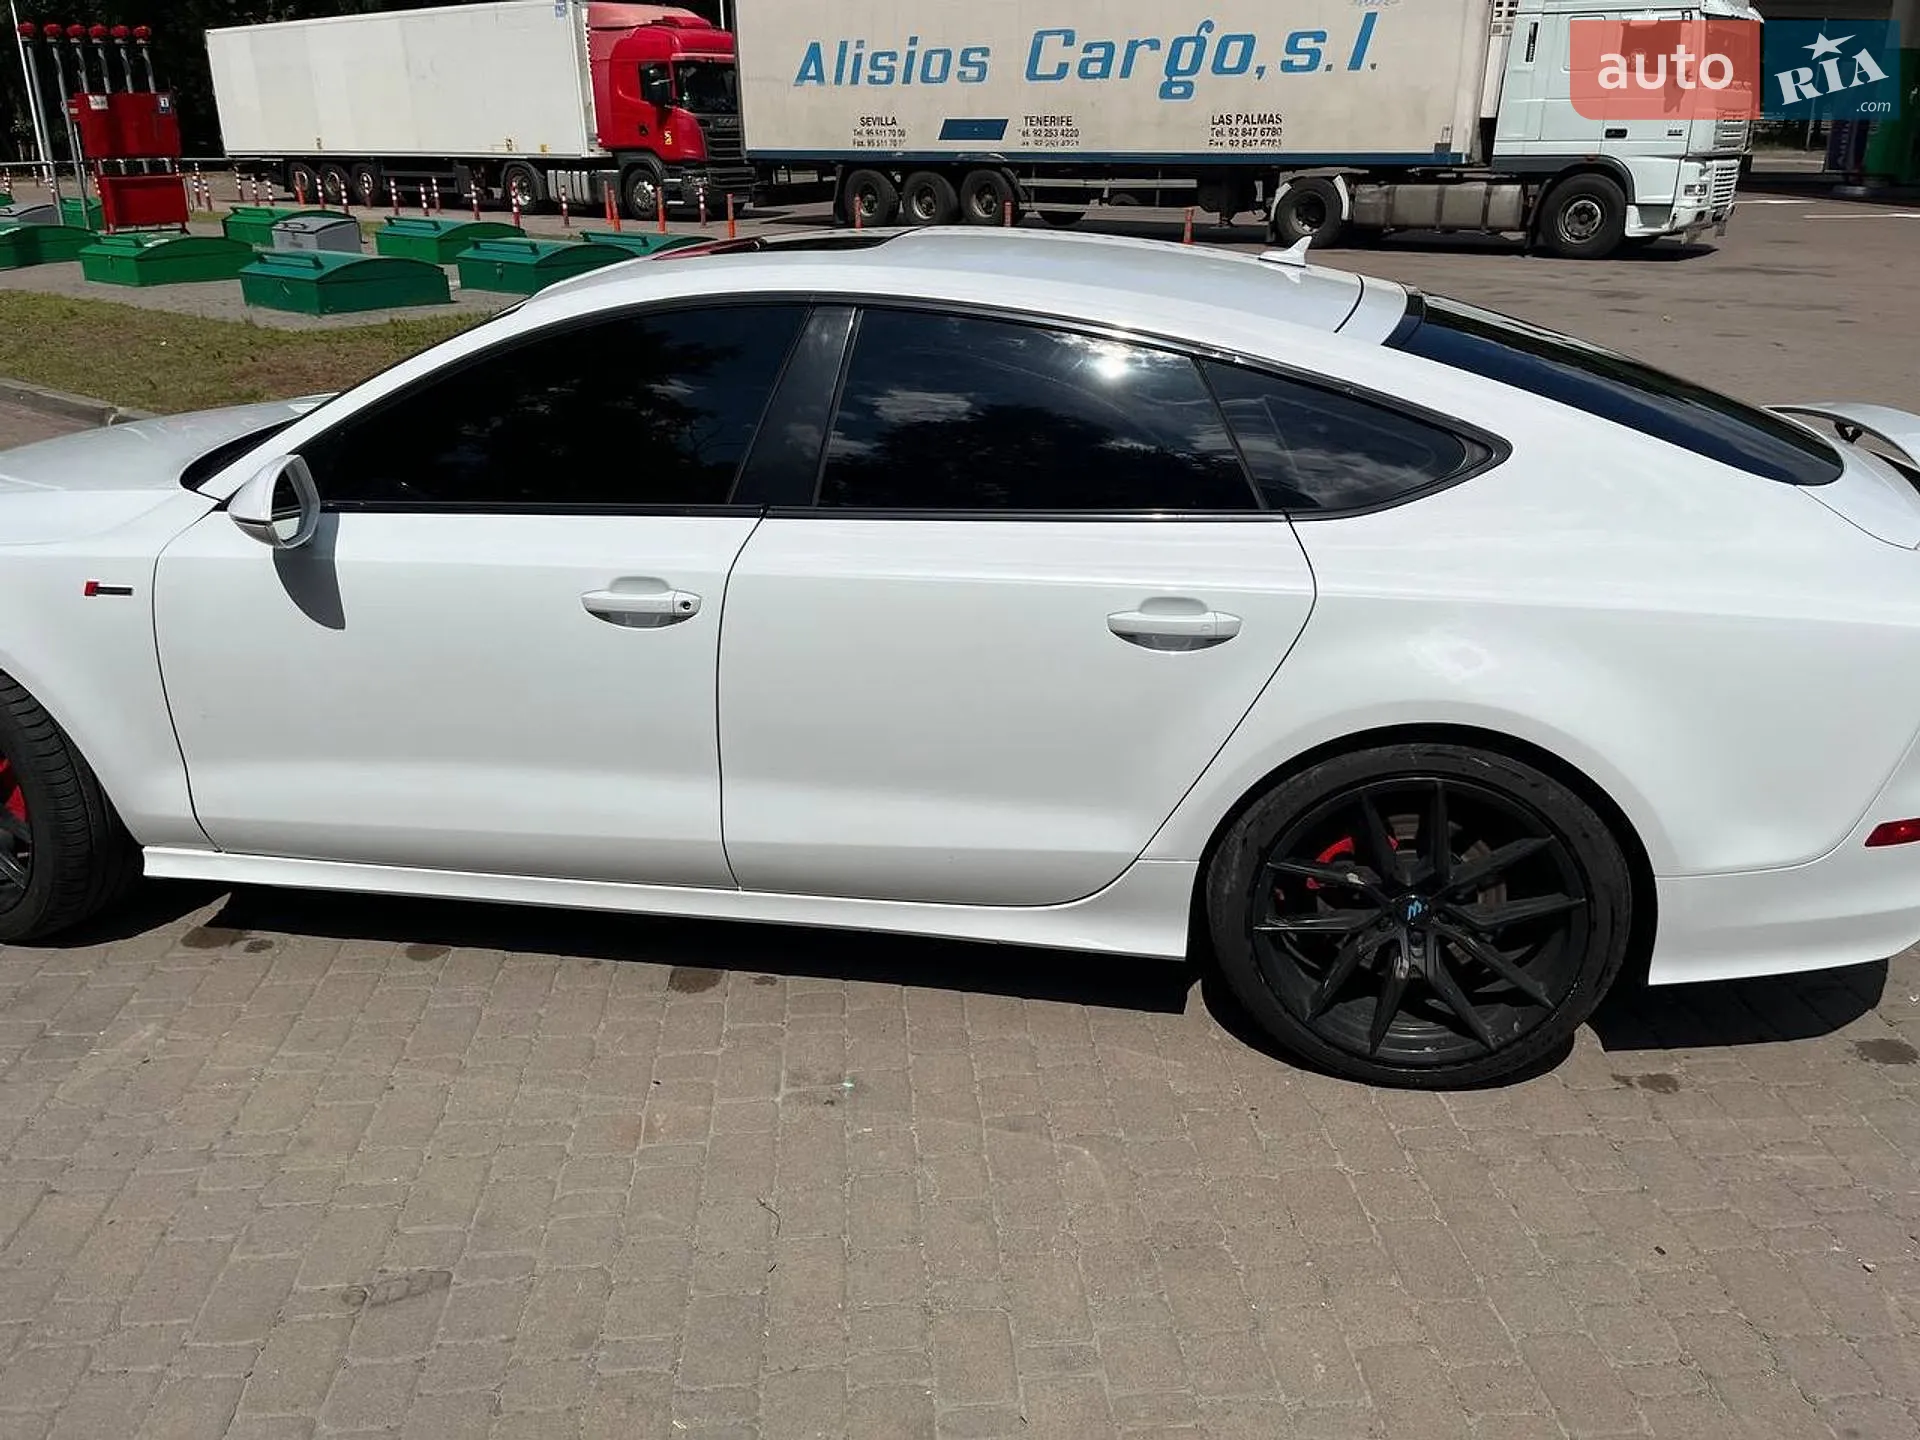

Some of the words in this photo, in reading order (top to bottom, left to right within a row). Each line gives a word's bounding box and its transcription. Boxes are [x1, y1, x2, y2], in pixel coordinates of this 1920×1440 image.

[793, 36, 990, 86] Alisios
[860, 116, 897, 127] SEVILLA
[1024, 116, 1073, 126] TENERIFE
[1212, 114, 1233, 125] LAS
[1236, 113, 1282, 125] PALMAS
[1228, 127, 1239, 137] 92
